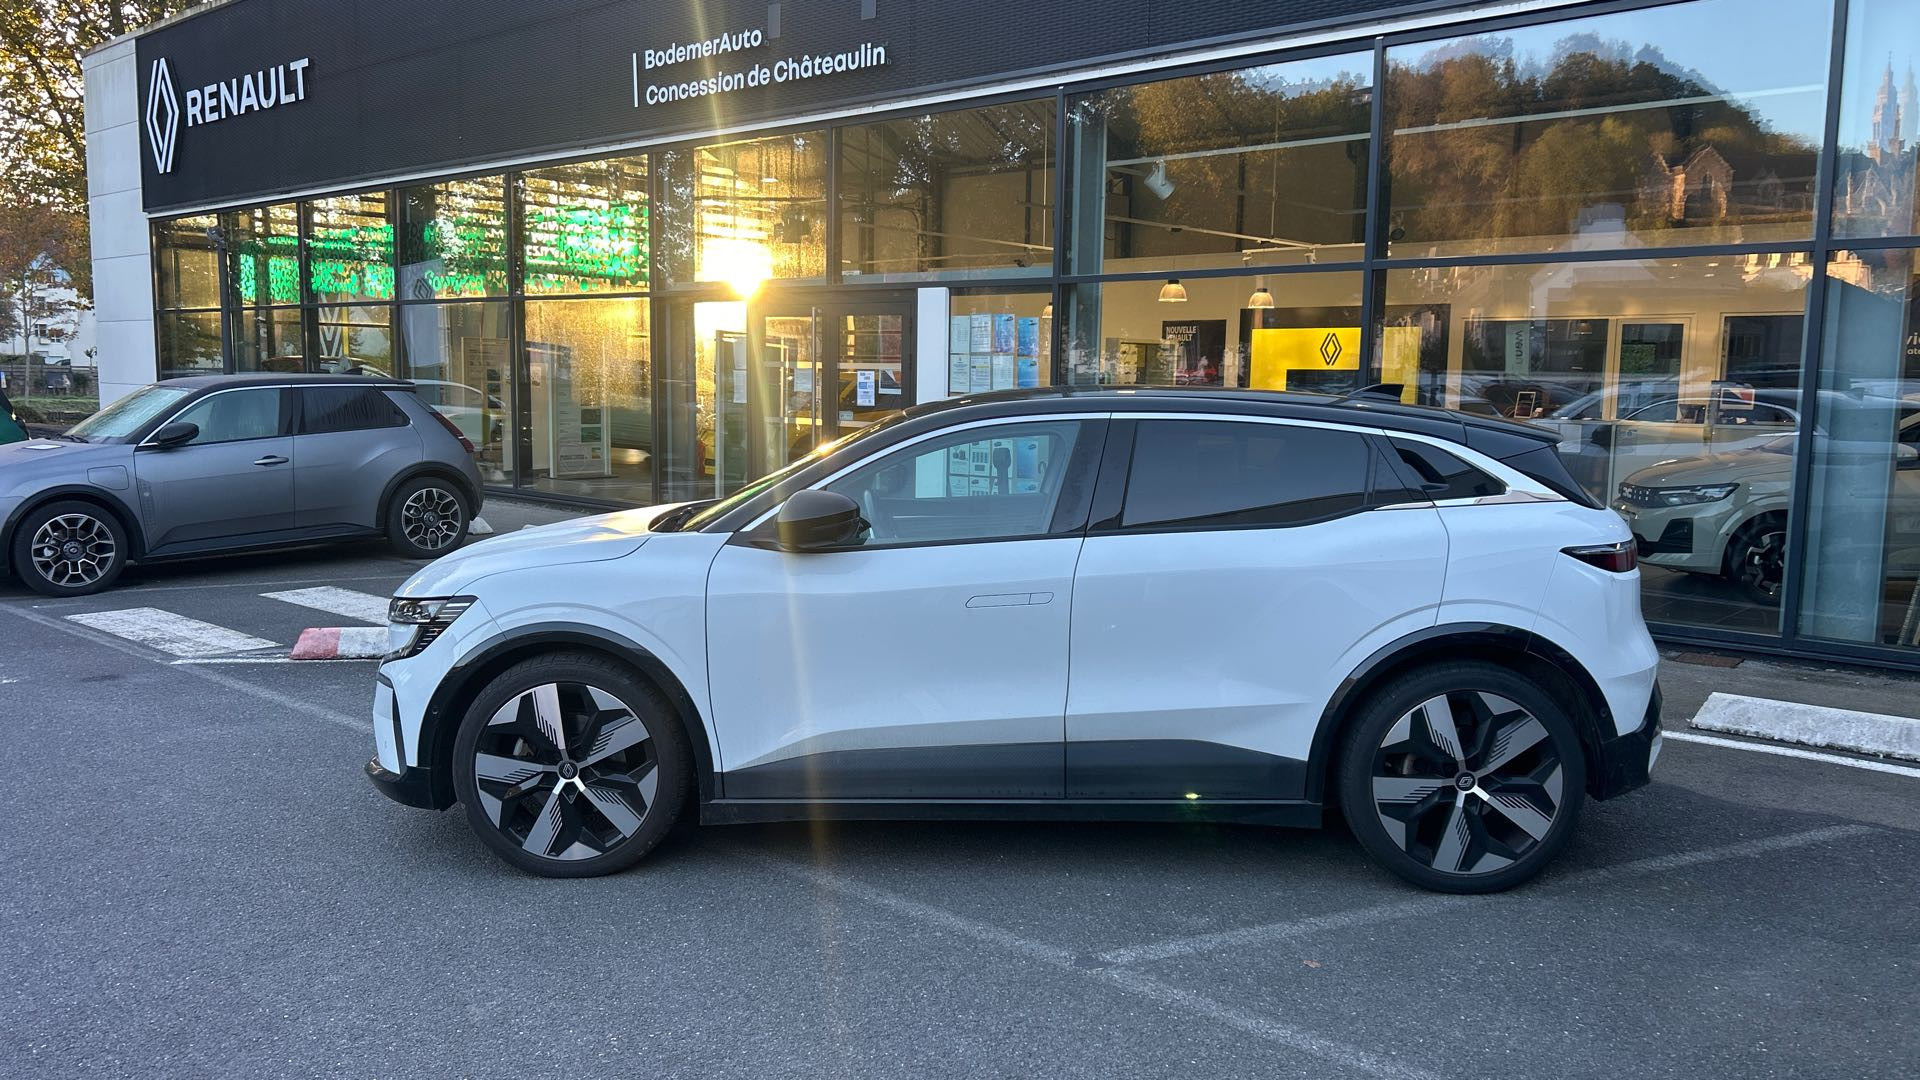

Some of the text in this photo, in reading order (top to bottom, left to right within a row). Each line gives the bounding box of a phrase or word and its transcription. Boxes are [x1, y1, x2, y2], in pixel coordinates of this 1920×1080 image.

[645, 29, 762, 69] BodemerAuto
[646, 42, 885, 105] Concession de Châteaulin
[186, 57, 309, 127] RENAULT
